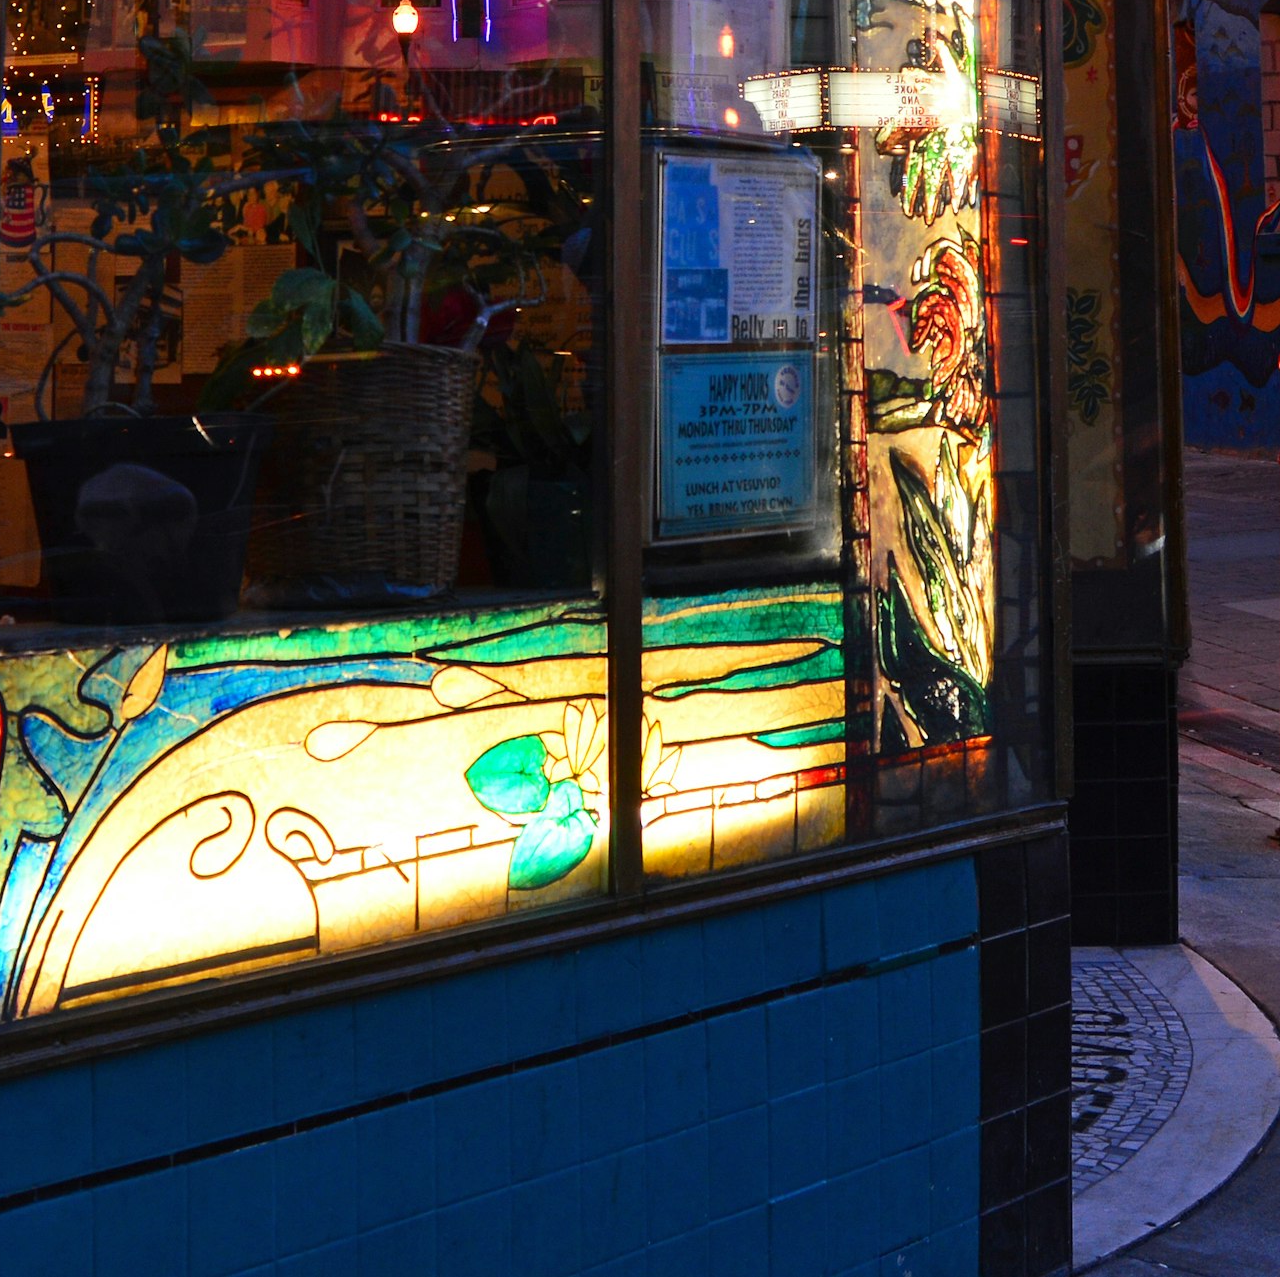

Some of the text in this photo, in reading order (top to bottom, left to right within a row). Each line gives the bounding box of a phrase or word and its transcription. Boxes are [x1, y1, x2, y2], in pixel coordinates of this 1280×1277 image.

[732, 314, 765, 340] Belly
[709, 373, 738, 402] HAPPY
[740, 372, 769, 401] HOURS
[699, 403, 778, 418] 3PM-7PM
[678, 420, 721, 439] MONDAY
[722, 419, 747, 437] THRU
[685, 477, 782, 497] LUNCH AT VESUVIO?
